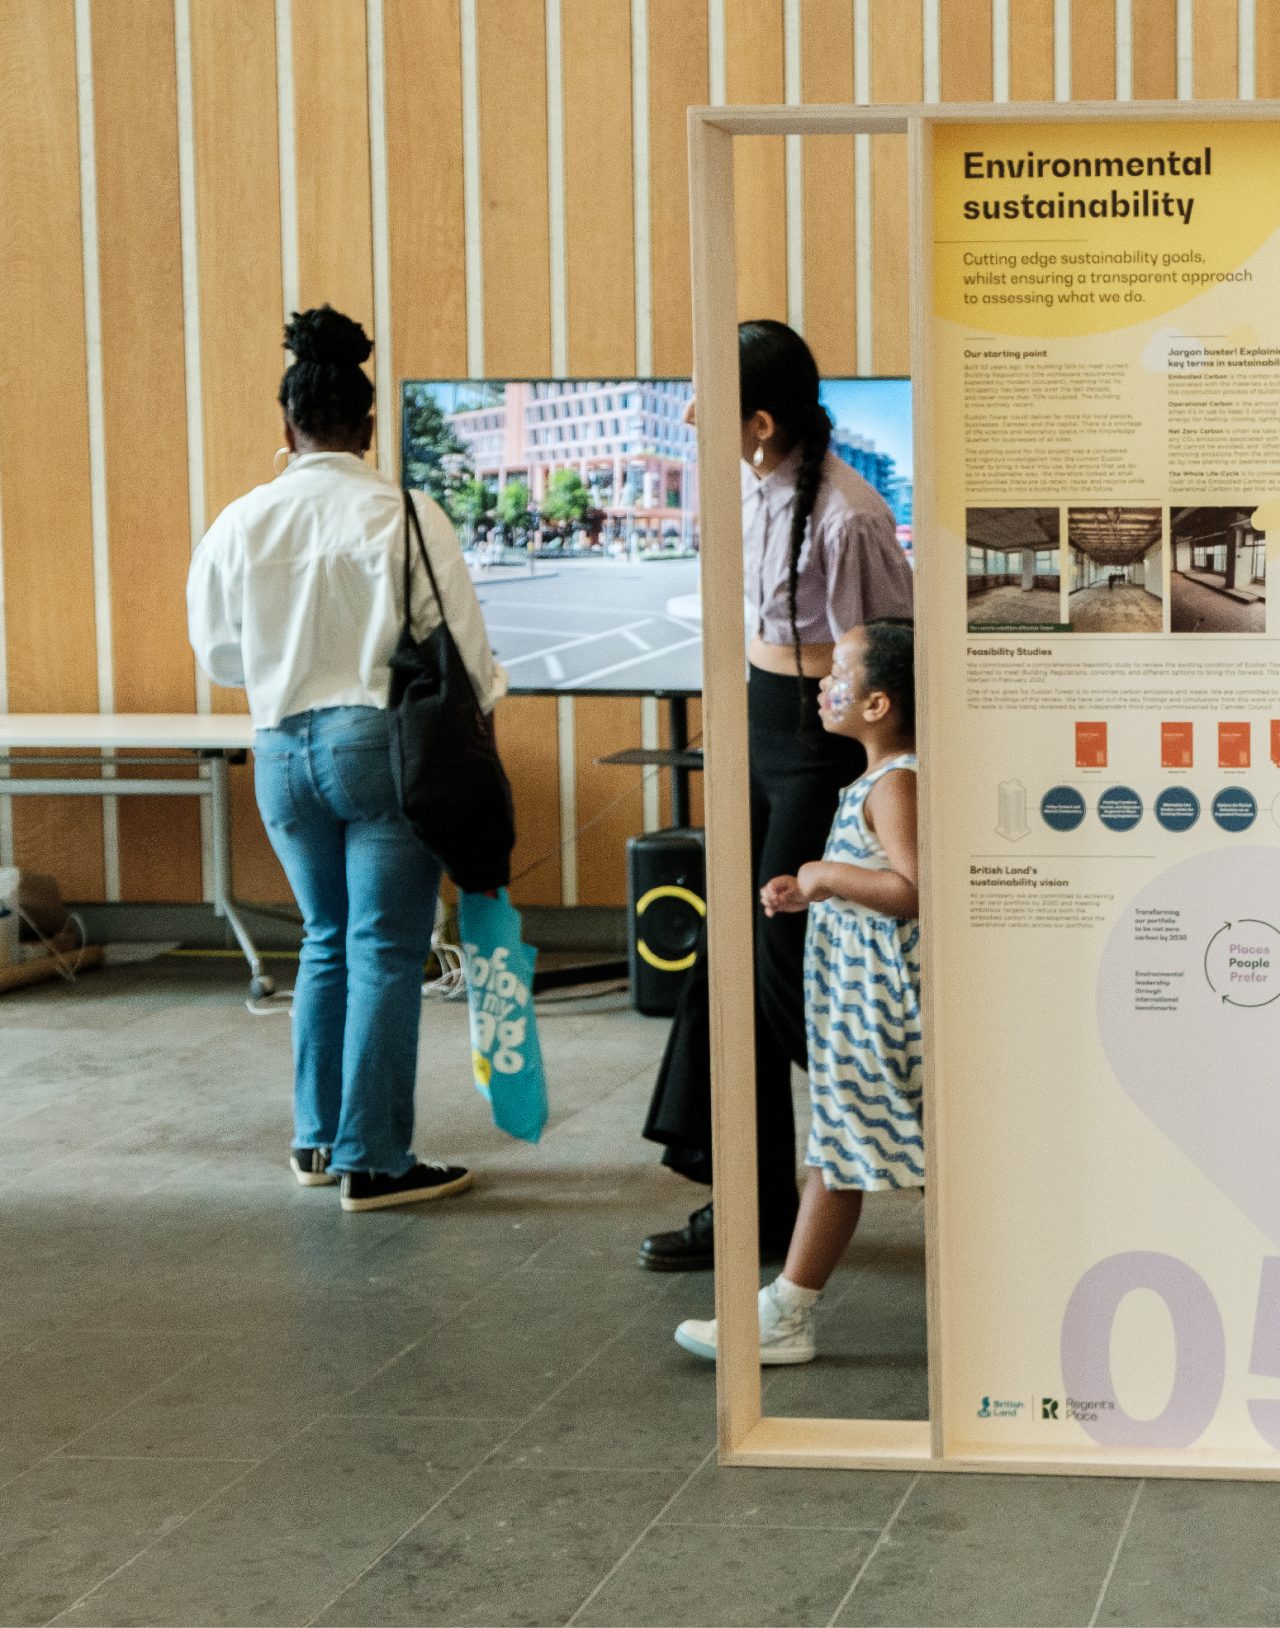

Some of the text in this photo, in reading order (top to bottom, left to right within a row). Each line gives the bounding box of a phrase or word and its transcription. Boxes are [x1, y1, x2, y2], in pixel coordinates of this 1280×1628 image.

[963, 147, 1211, 179] Environmental
[963, 190, 1194, 223] sustainability
[963, 250, 1206, 268] Cutting edge sustainability goals,
[963, 269, 1252, 287] whilst ensuring a transparent approach
[963, 290, 1146, 306] to assessing what we do.
[983, 350, 1020, 358] starting
[1022, 350, 1048, 358] point
[1168, 349, 1201, 357] Jargon
[1168, 360, 1184, 368] key
[967, 648, 1052, 658] Feasibility Studies
[970, 866, 1038, 875] British Land's
[970, 878, 1069, 889] sustainability vision
[1229, 944, 1270, 954] Places
[1229, 958, 1270, 970] People
[1230, 972, 1268, 982] Prefer
[1066, 1398, 1114, 1411] Regent's
[1066, 1410, 1098, 1421] Place
